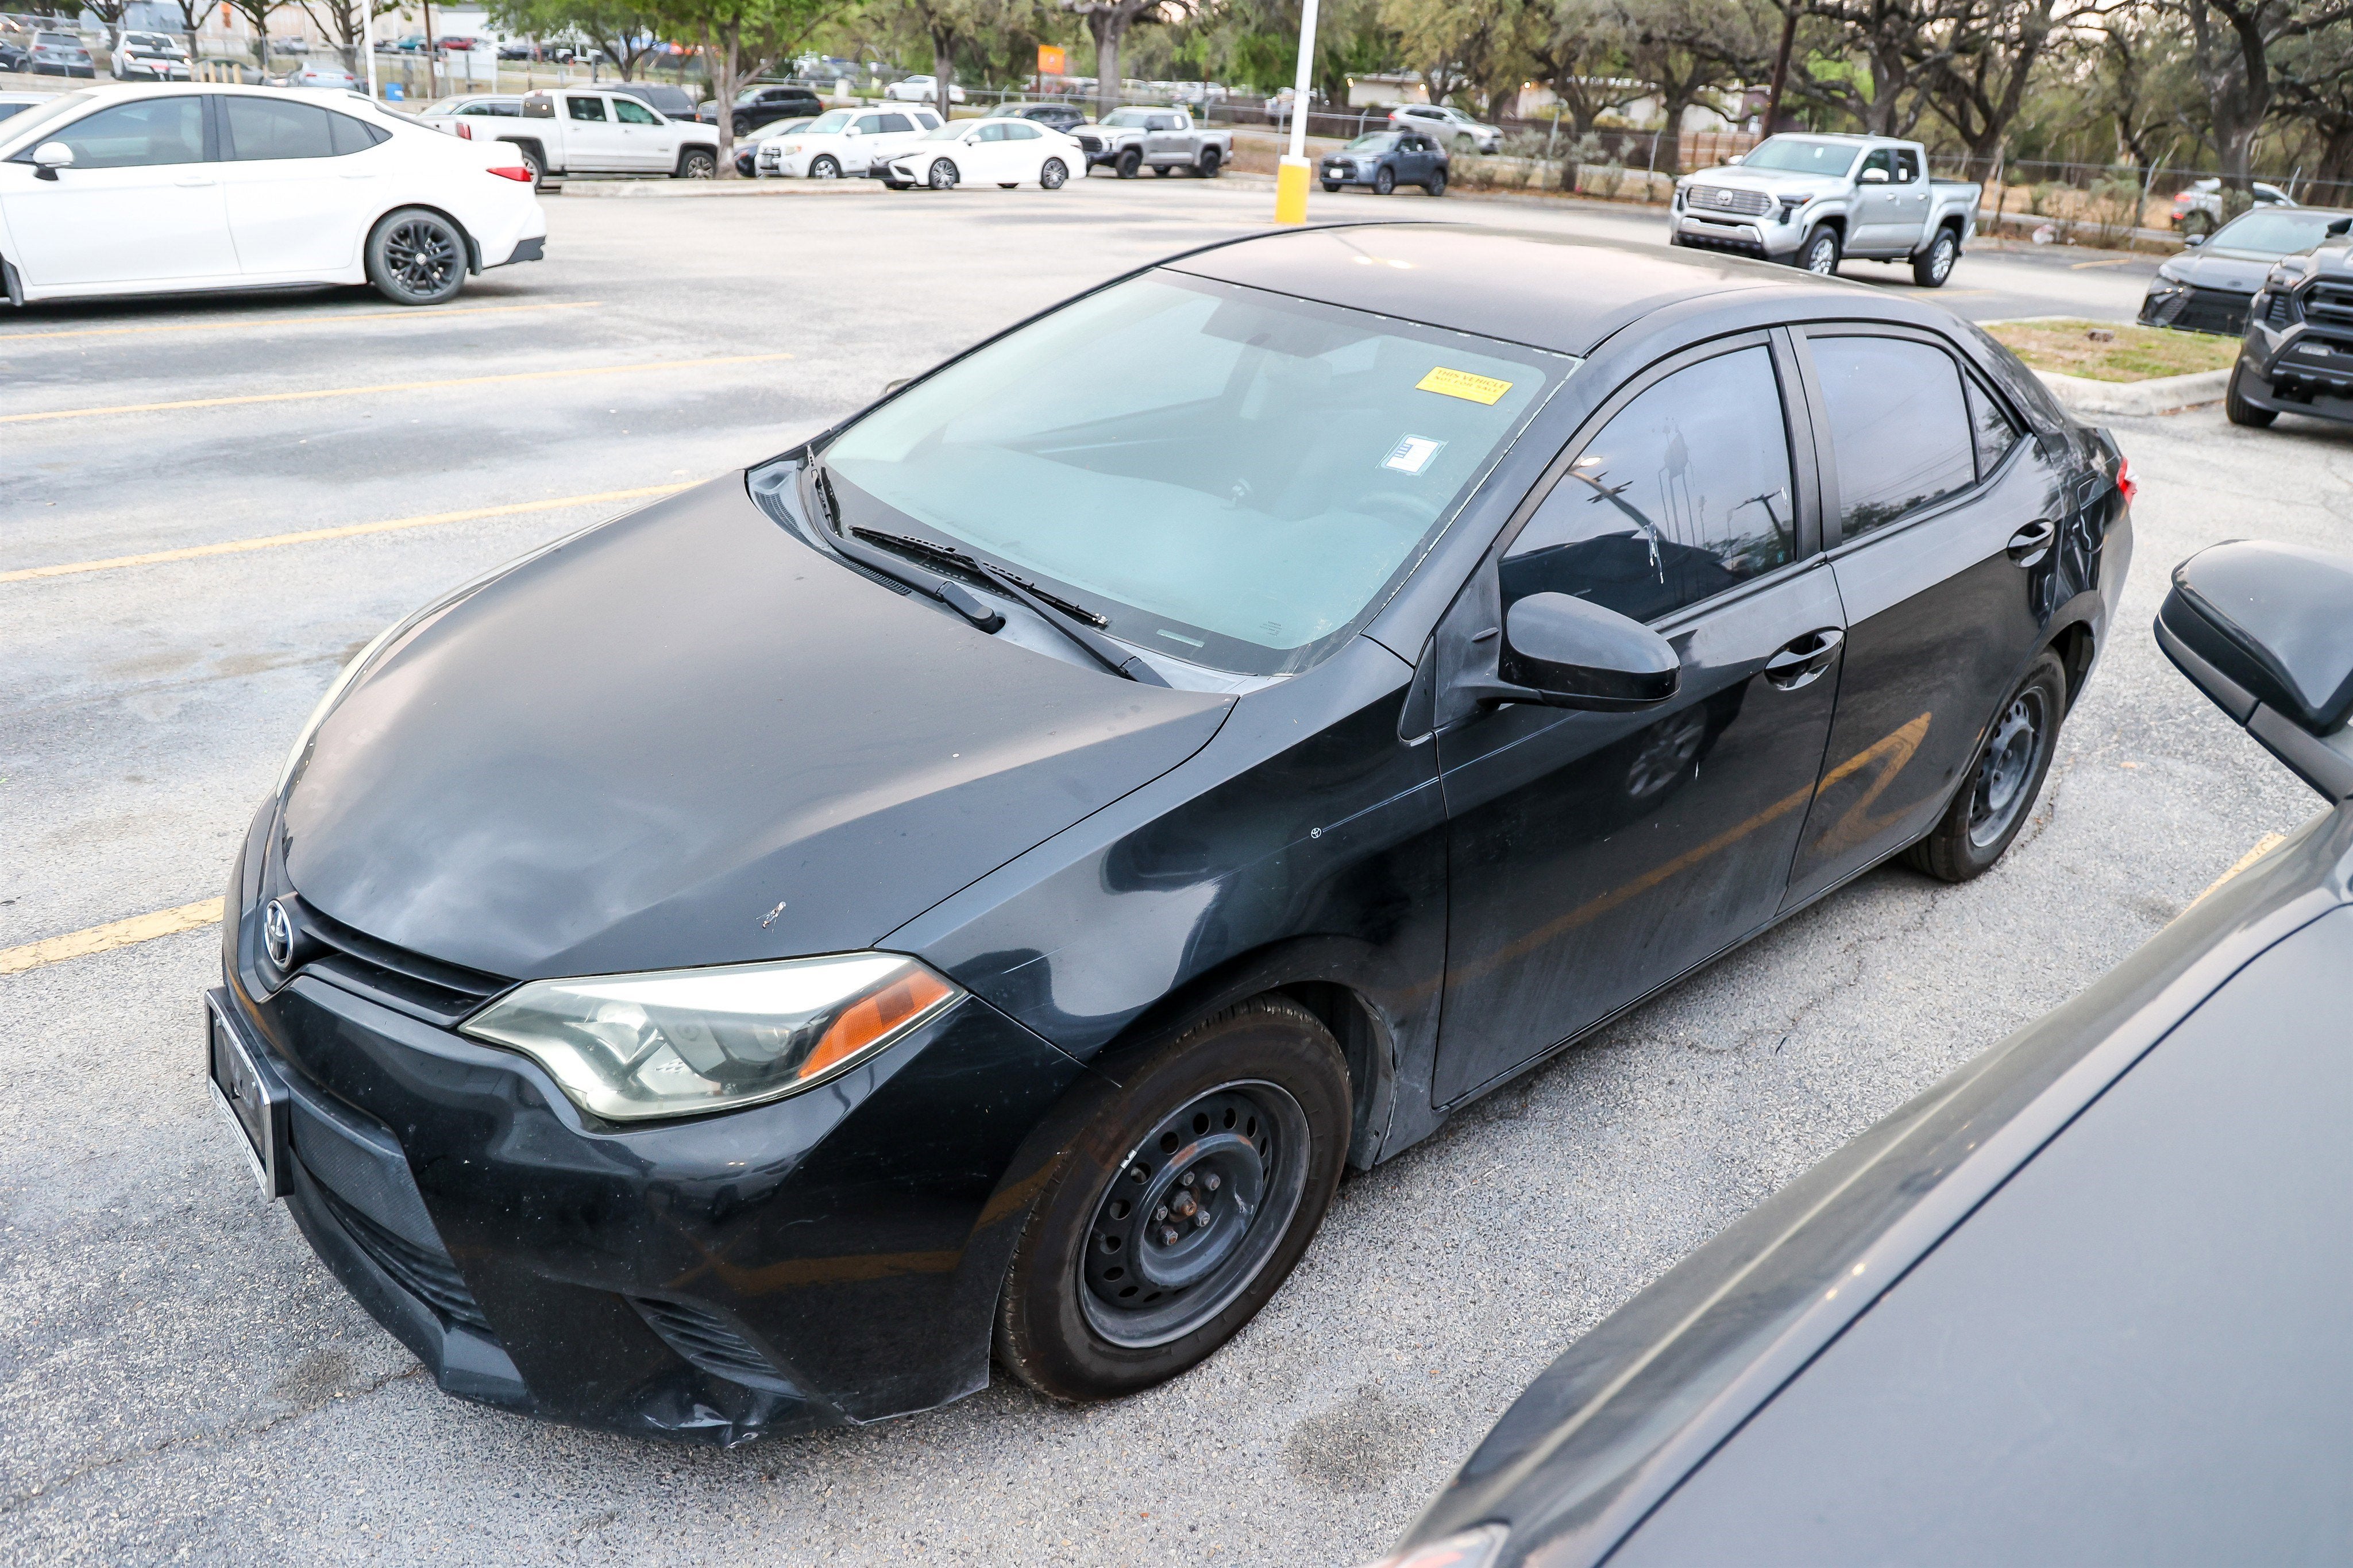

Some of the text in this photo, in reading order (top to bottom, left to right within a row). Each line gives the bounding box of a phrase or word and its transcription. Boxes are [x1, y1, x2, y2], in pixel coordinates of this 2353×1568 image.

[1437, 369, 1505, 389] THIS VEHICLE
[1475, 384, 1498, 392] SALE
